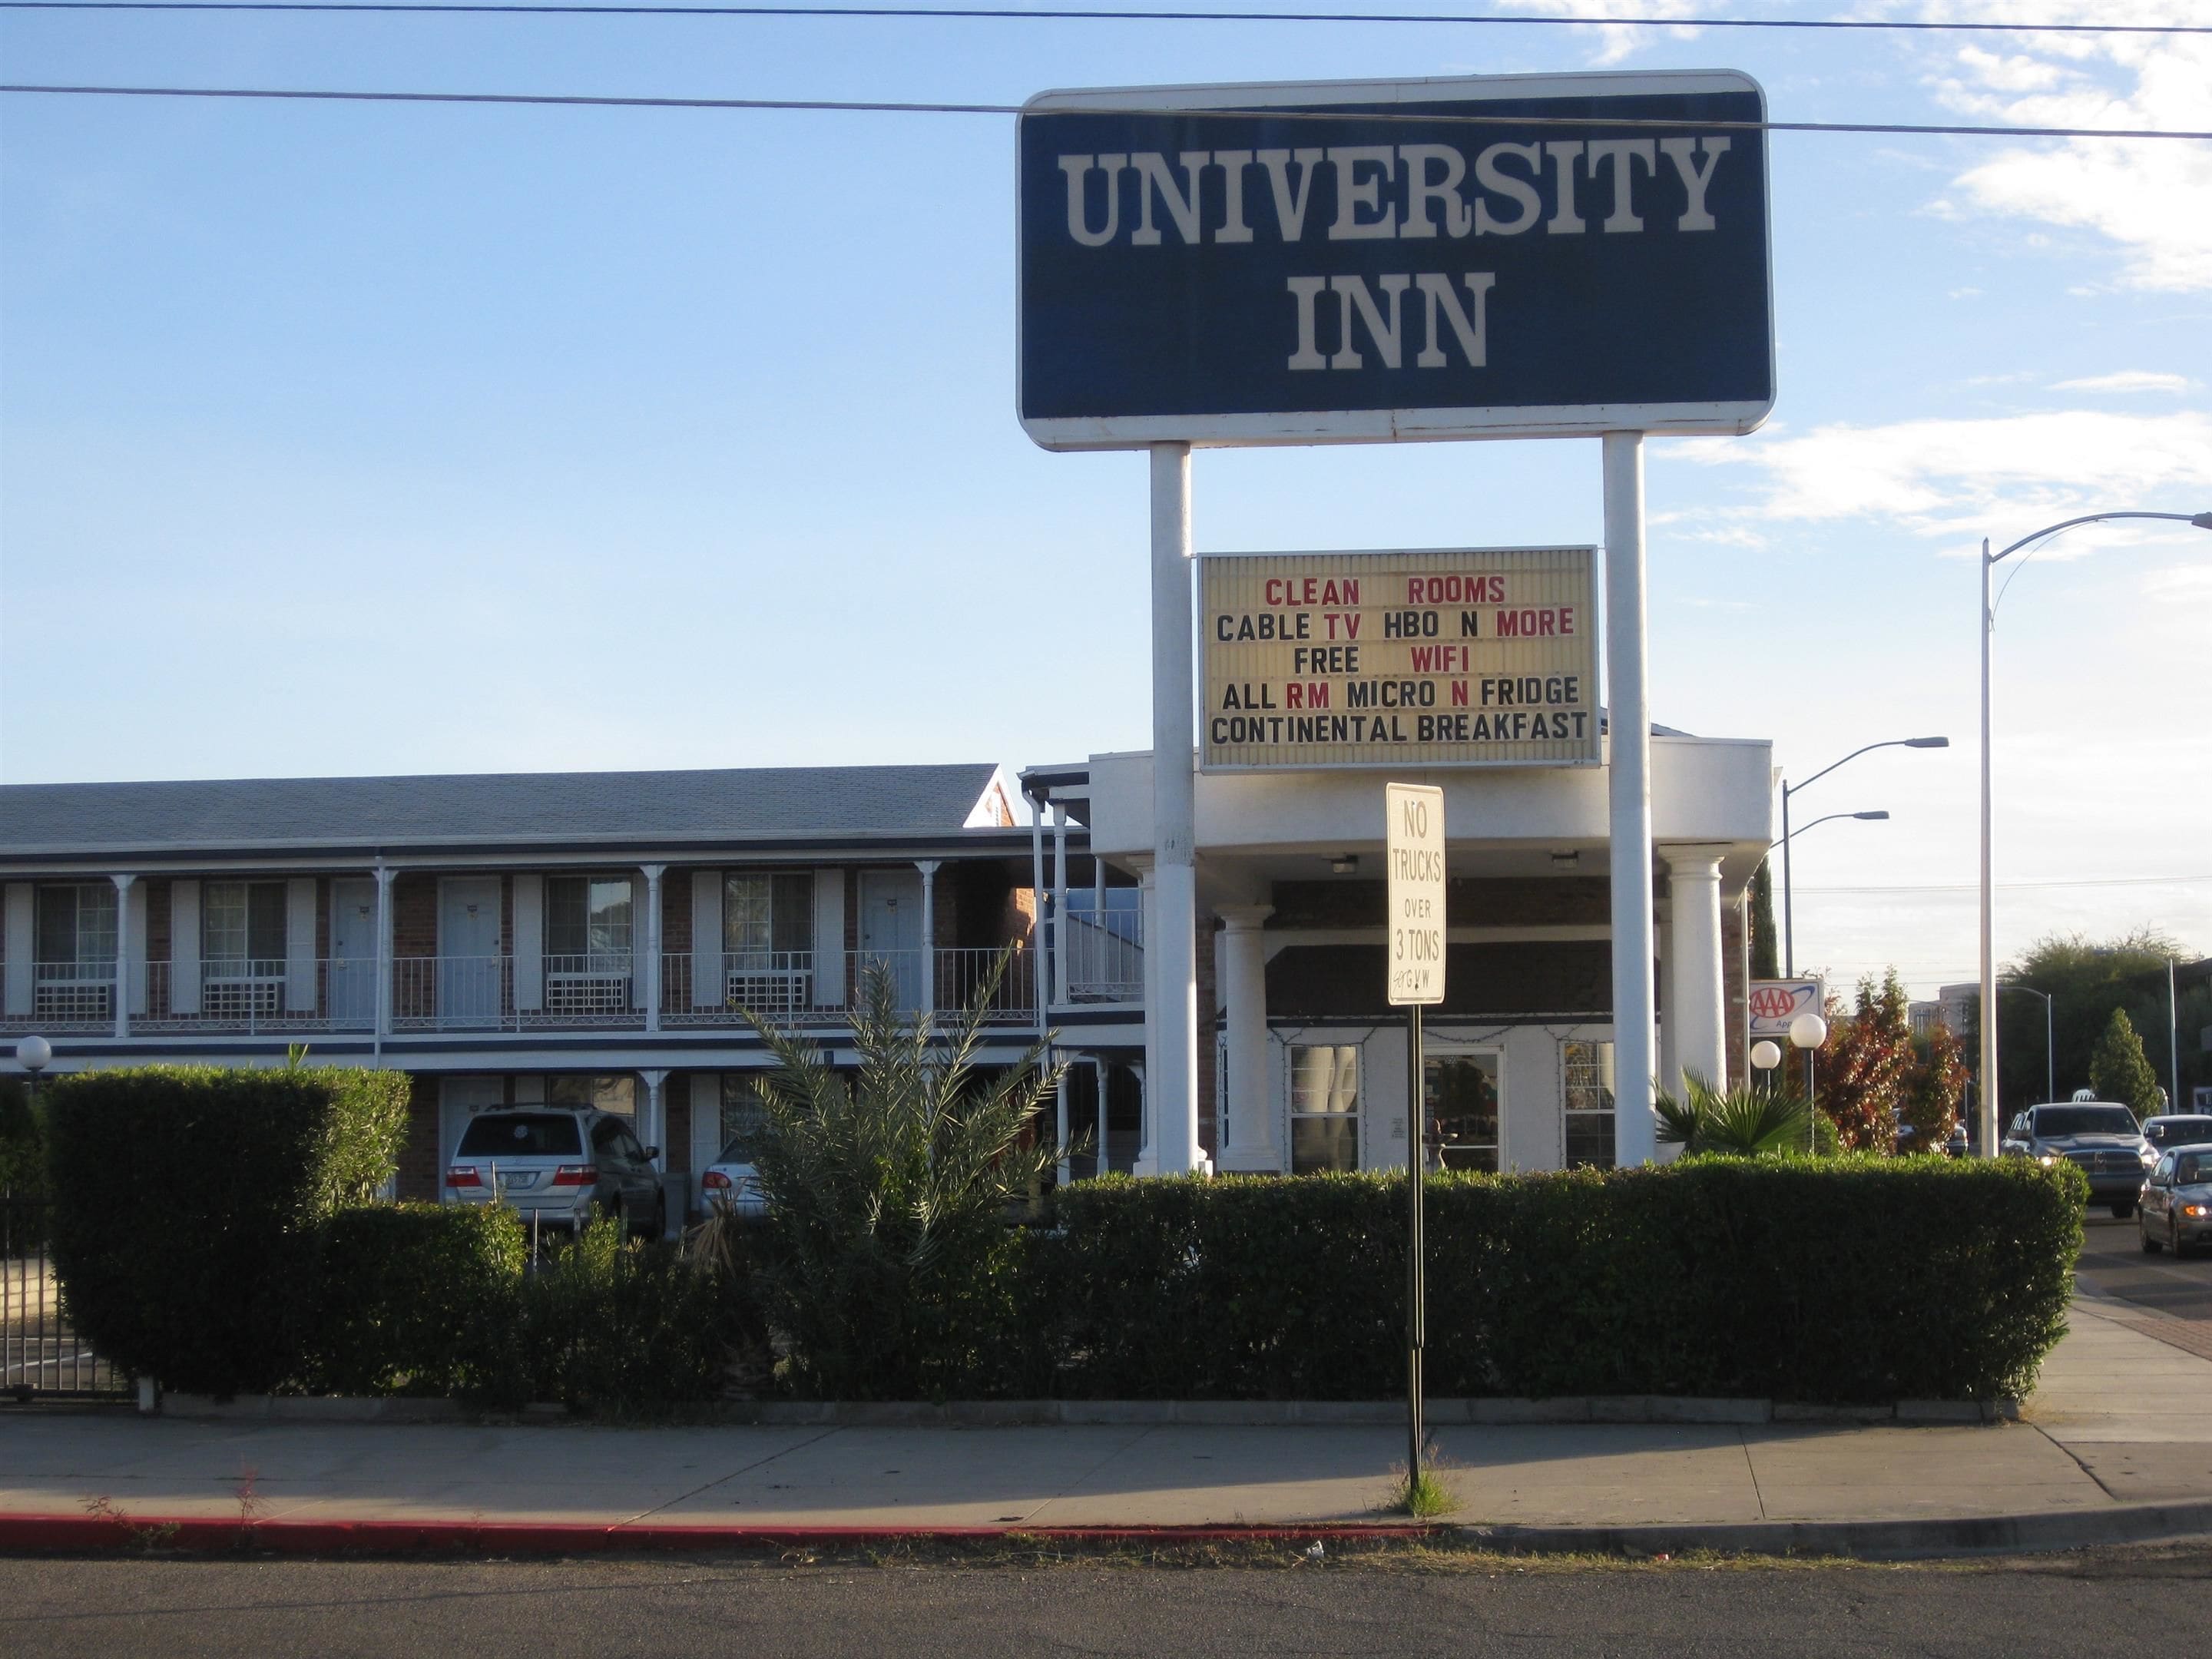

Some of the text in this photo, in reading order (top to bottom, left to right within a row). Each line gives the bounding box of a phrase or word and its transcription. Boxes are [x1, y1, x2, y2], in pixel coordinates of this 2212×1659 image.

[1058, 137, 1730, 246] UNIVERSITY
[1286, 272, 1495, 370] INN
[1266, 576, 1505, 605] CLEAN ROOMS
[1217, 608, 1574, 641] CABLE TV HBO N MORE
[1294, 645, 1469, 674] FREE WIFI
[1223, 677, 1578, 710] ALL RM MICRO N FRIDGE
[1211, 711, 1588, 743] CONTINENTAL BREAKFAST
[1404, 800, 1427, 839] NO
[1392, 848, 1441, 882] TRUCKS
[1405, 898, 1431, 918] OVER
[1396, 929, 1439, 961] 3 TONS
[1752, 988, 1792, 1017] AAA
